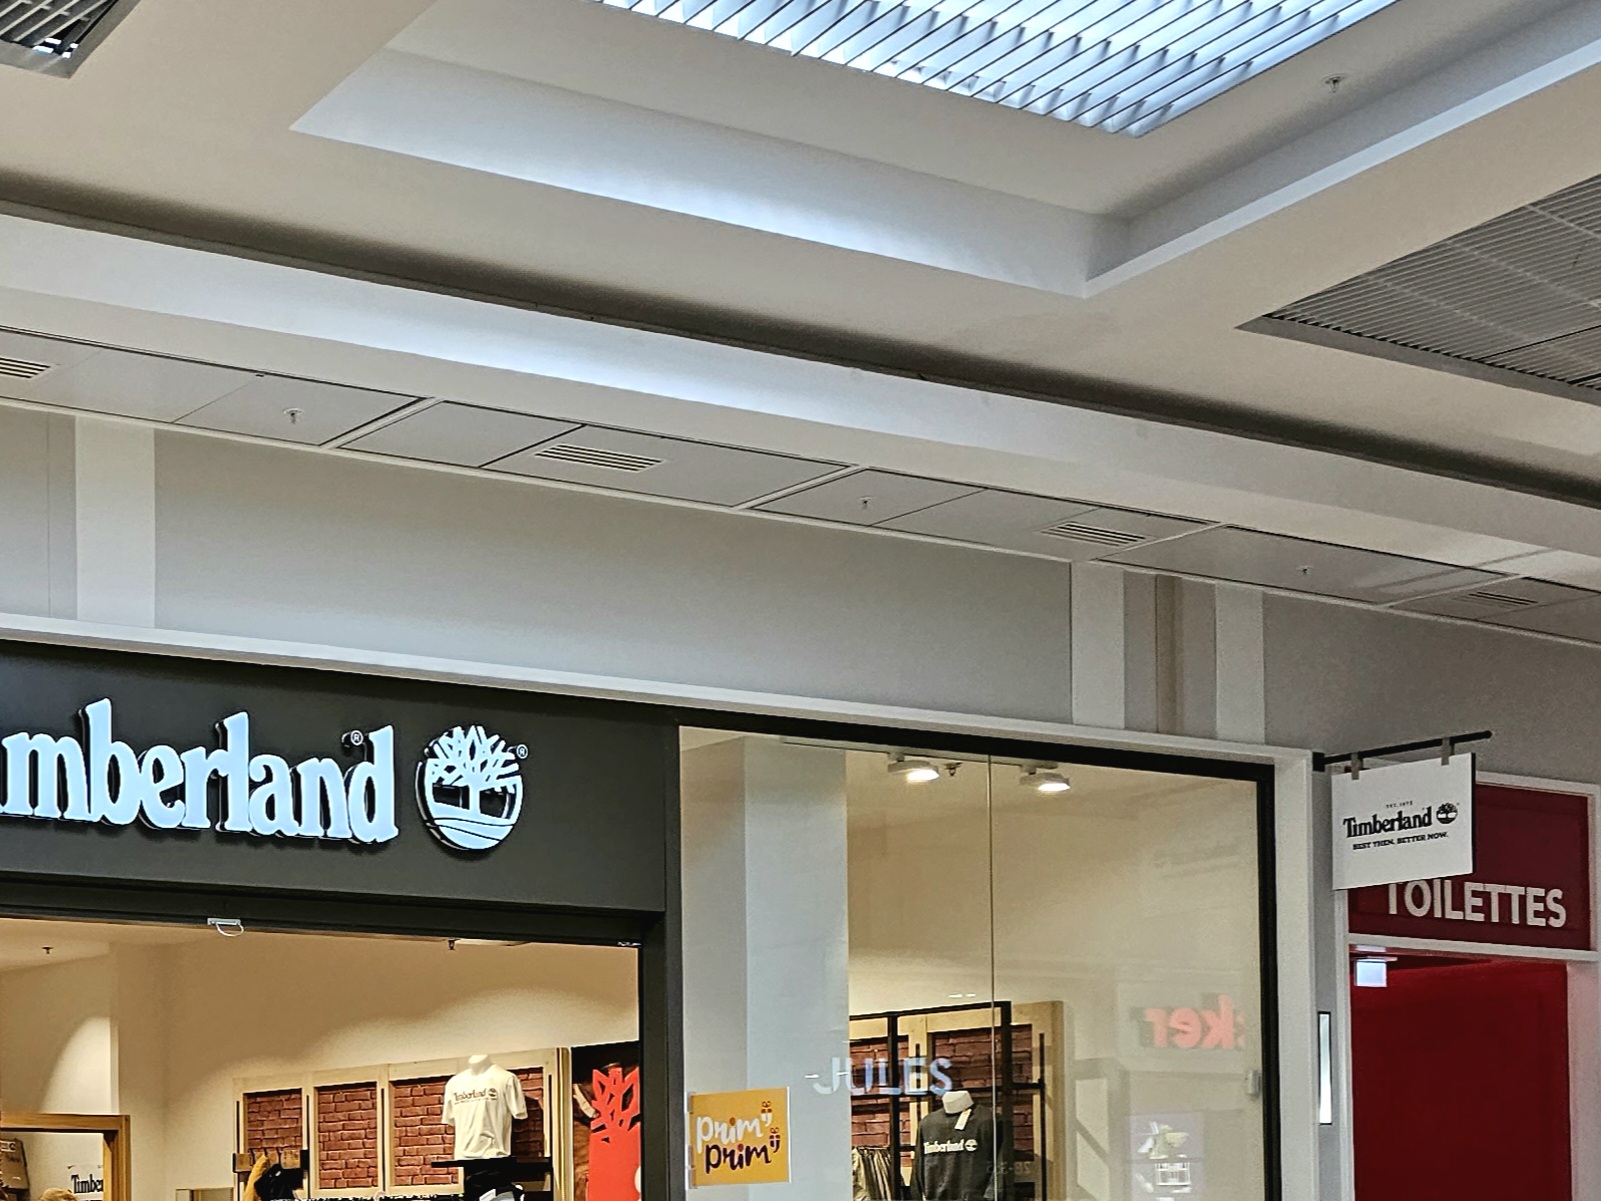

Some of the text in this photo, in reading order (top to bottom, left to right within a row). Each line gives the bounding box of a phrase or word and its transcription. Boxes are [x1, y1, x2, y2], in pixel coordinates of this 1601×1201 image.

[1343, 806, 1433, 838] Timberland
[1397, 834, 1426, 844] BETTER
[1388, 879, 1567, 928] TOILETTES
[812, 1057, 953, 1096] JULES
